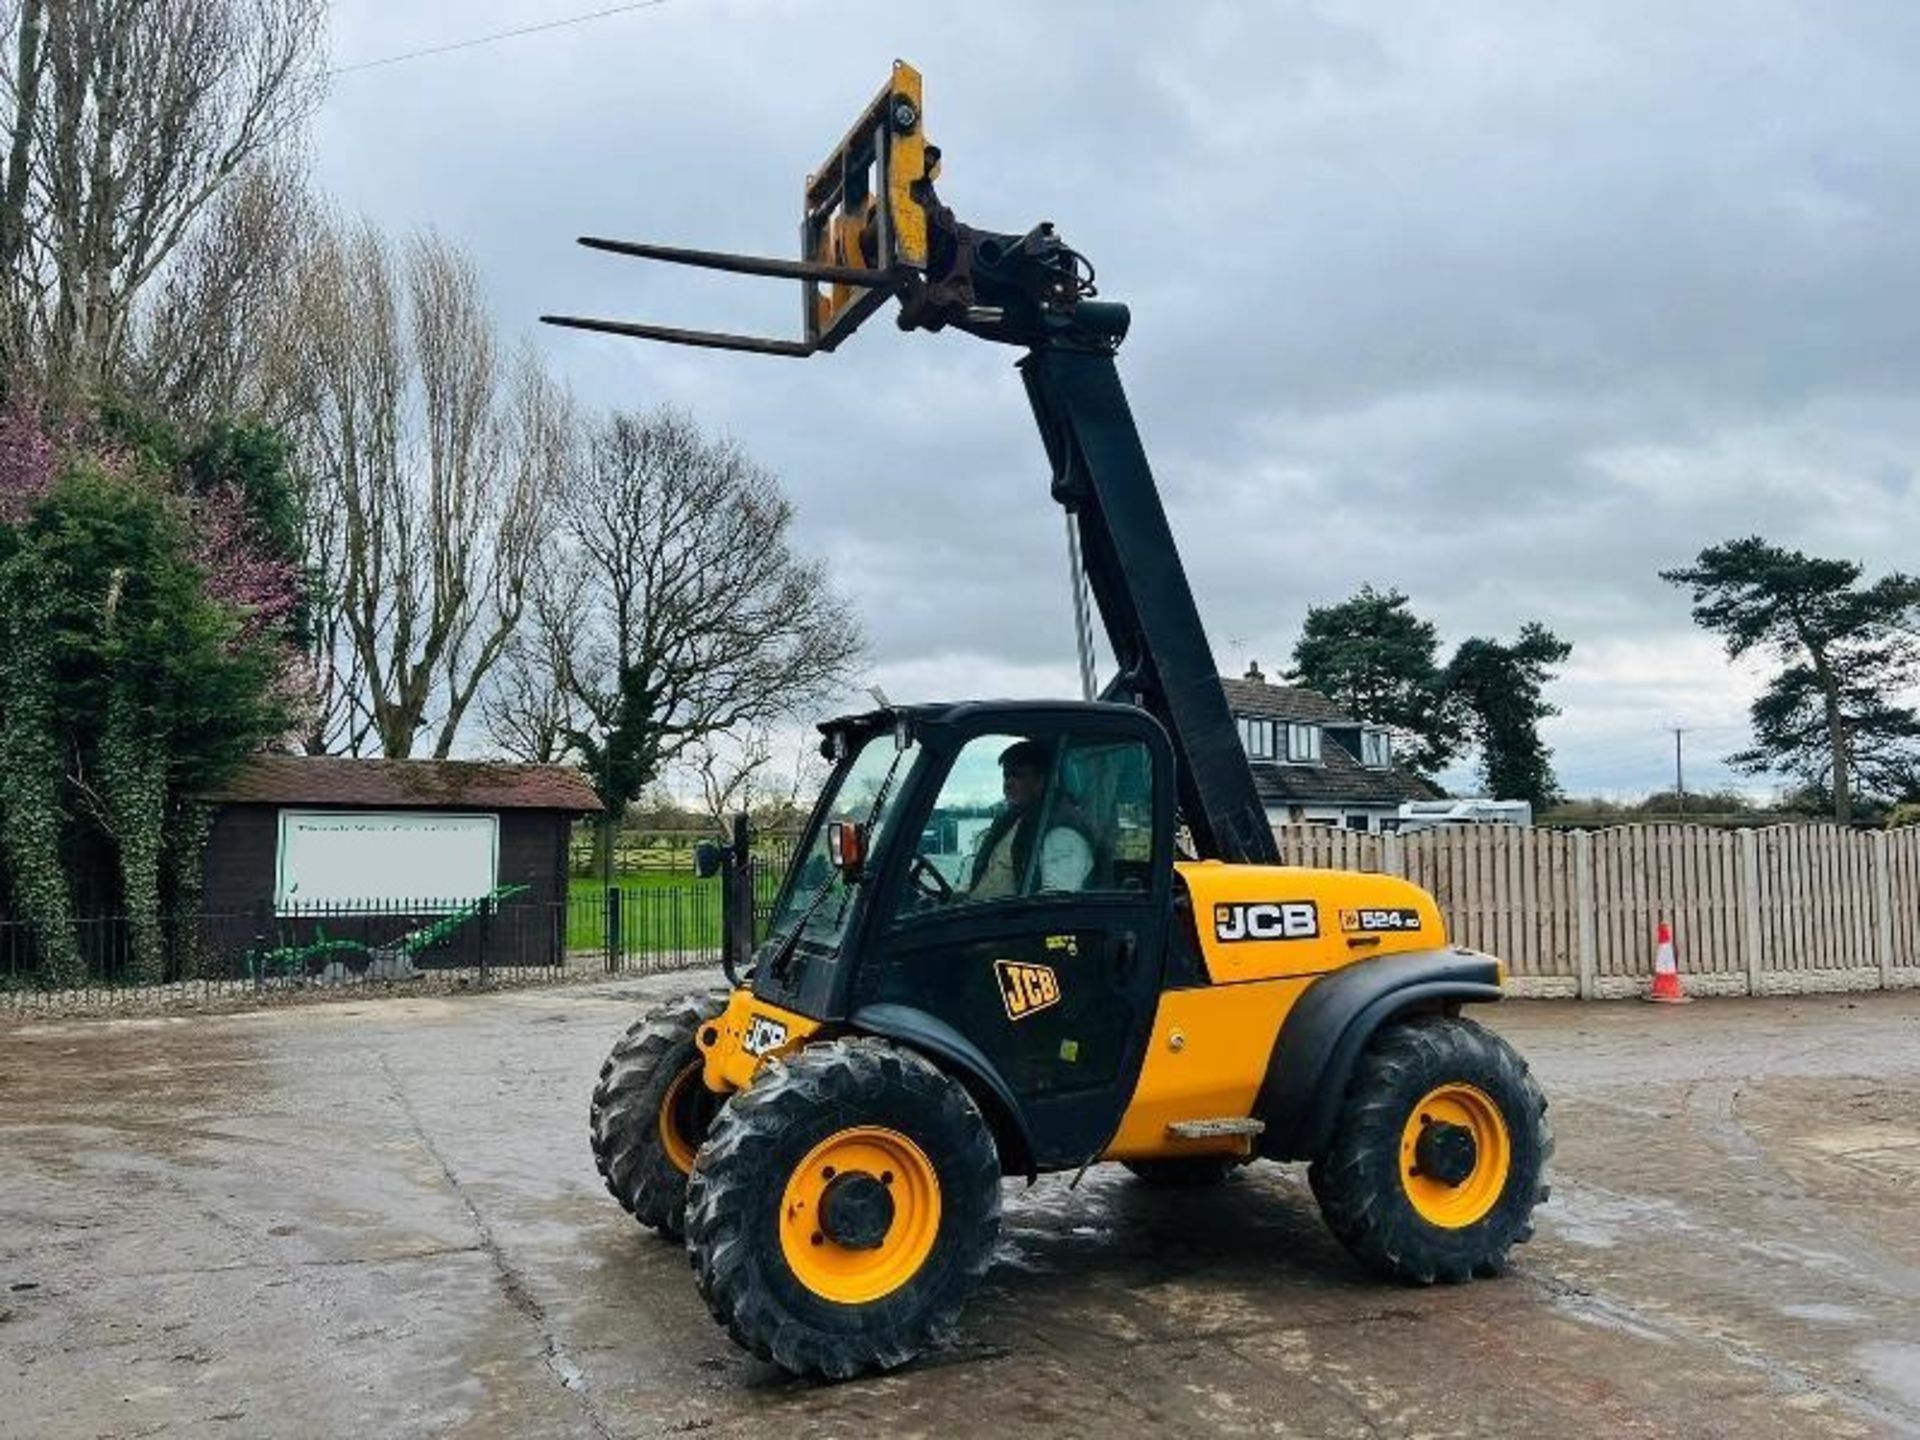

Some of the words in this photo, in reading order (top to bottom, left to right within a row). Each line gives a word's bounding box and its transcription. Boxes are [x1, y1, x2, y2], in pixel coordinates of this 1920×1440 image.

[1217, 904, 1316, 939] JCB
[1361, 911, 1402, 929] 524
[1006, 967, 1055, 1013] JCB
[745, 1018, 785, 1053] JCB
